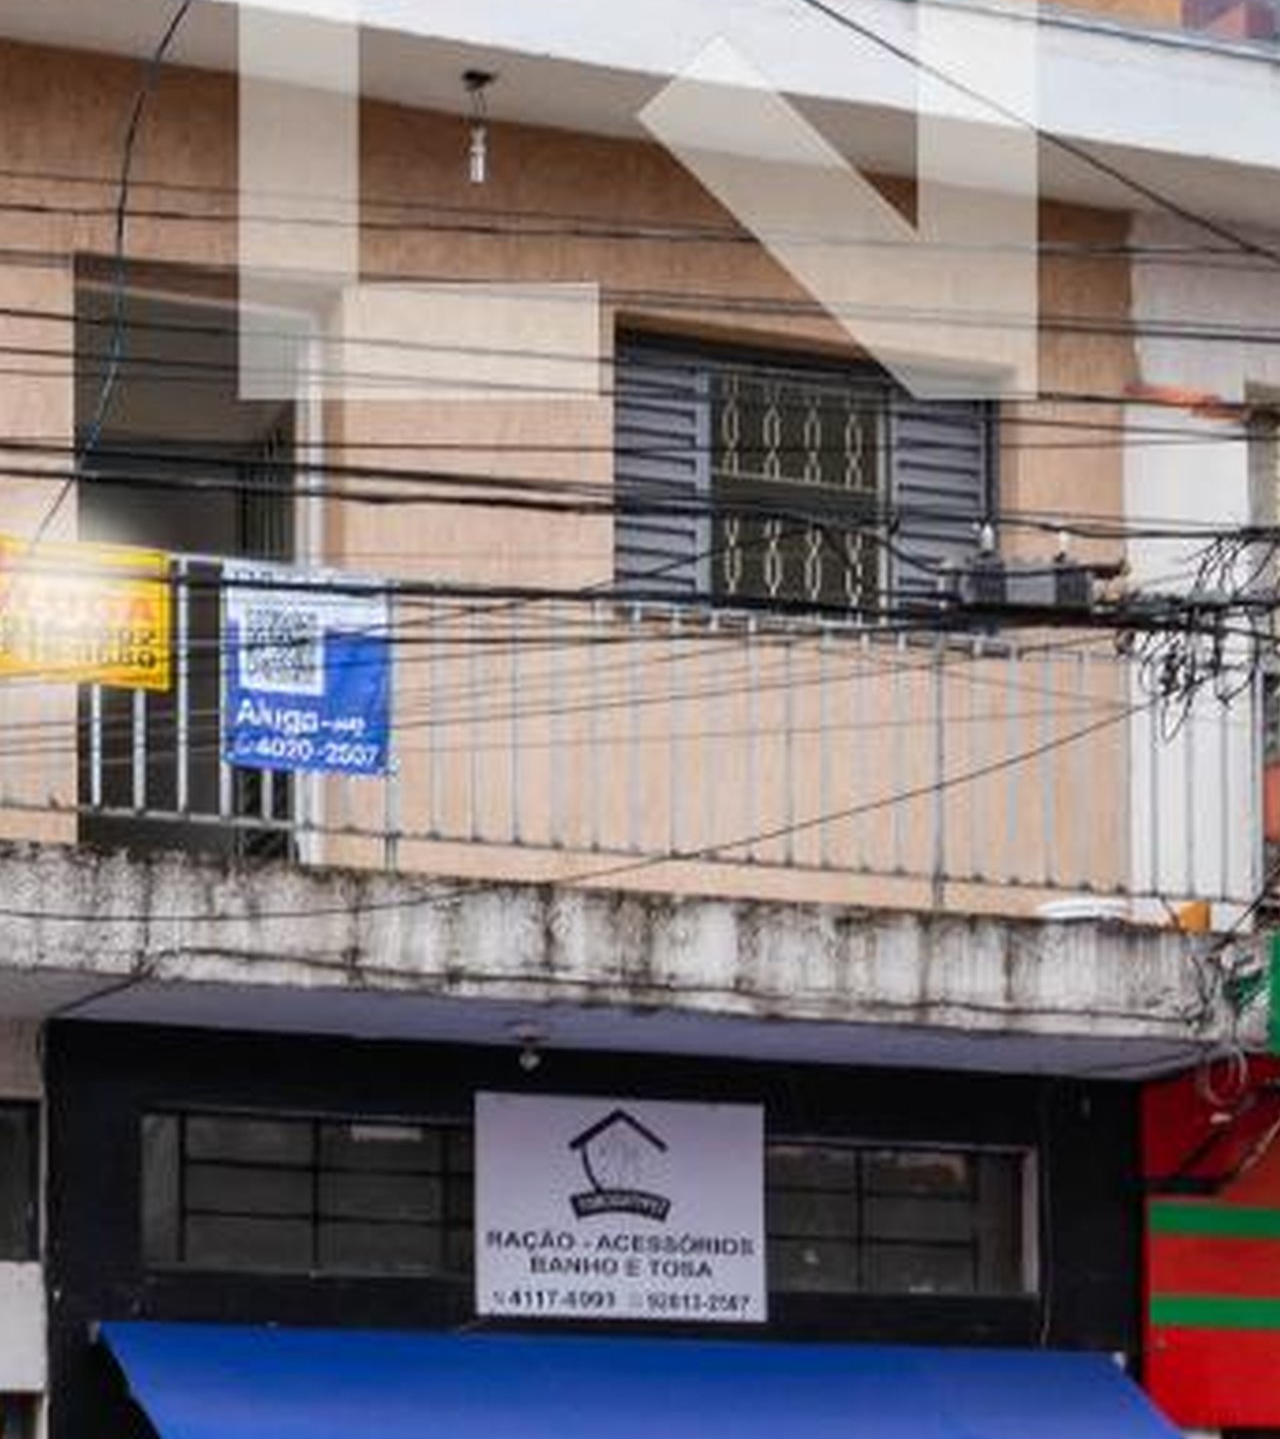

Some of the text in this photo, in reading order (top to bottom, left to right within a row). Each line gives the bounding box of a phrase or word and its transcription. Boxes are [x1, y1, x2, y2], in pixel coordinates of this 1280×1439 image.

[486, 1230, 576, 1252] RAÇÃO
[595, 1233, 755, 1256] ACESSÓRIOS
[530, 1257, 714, 1278] BANHO E TOSA
